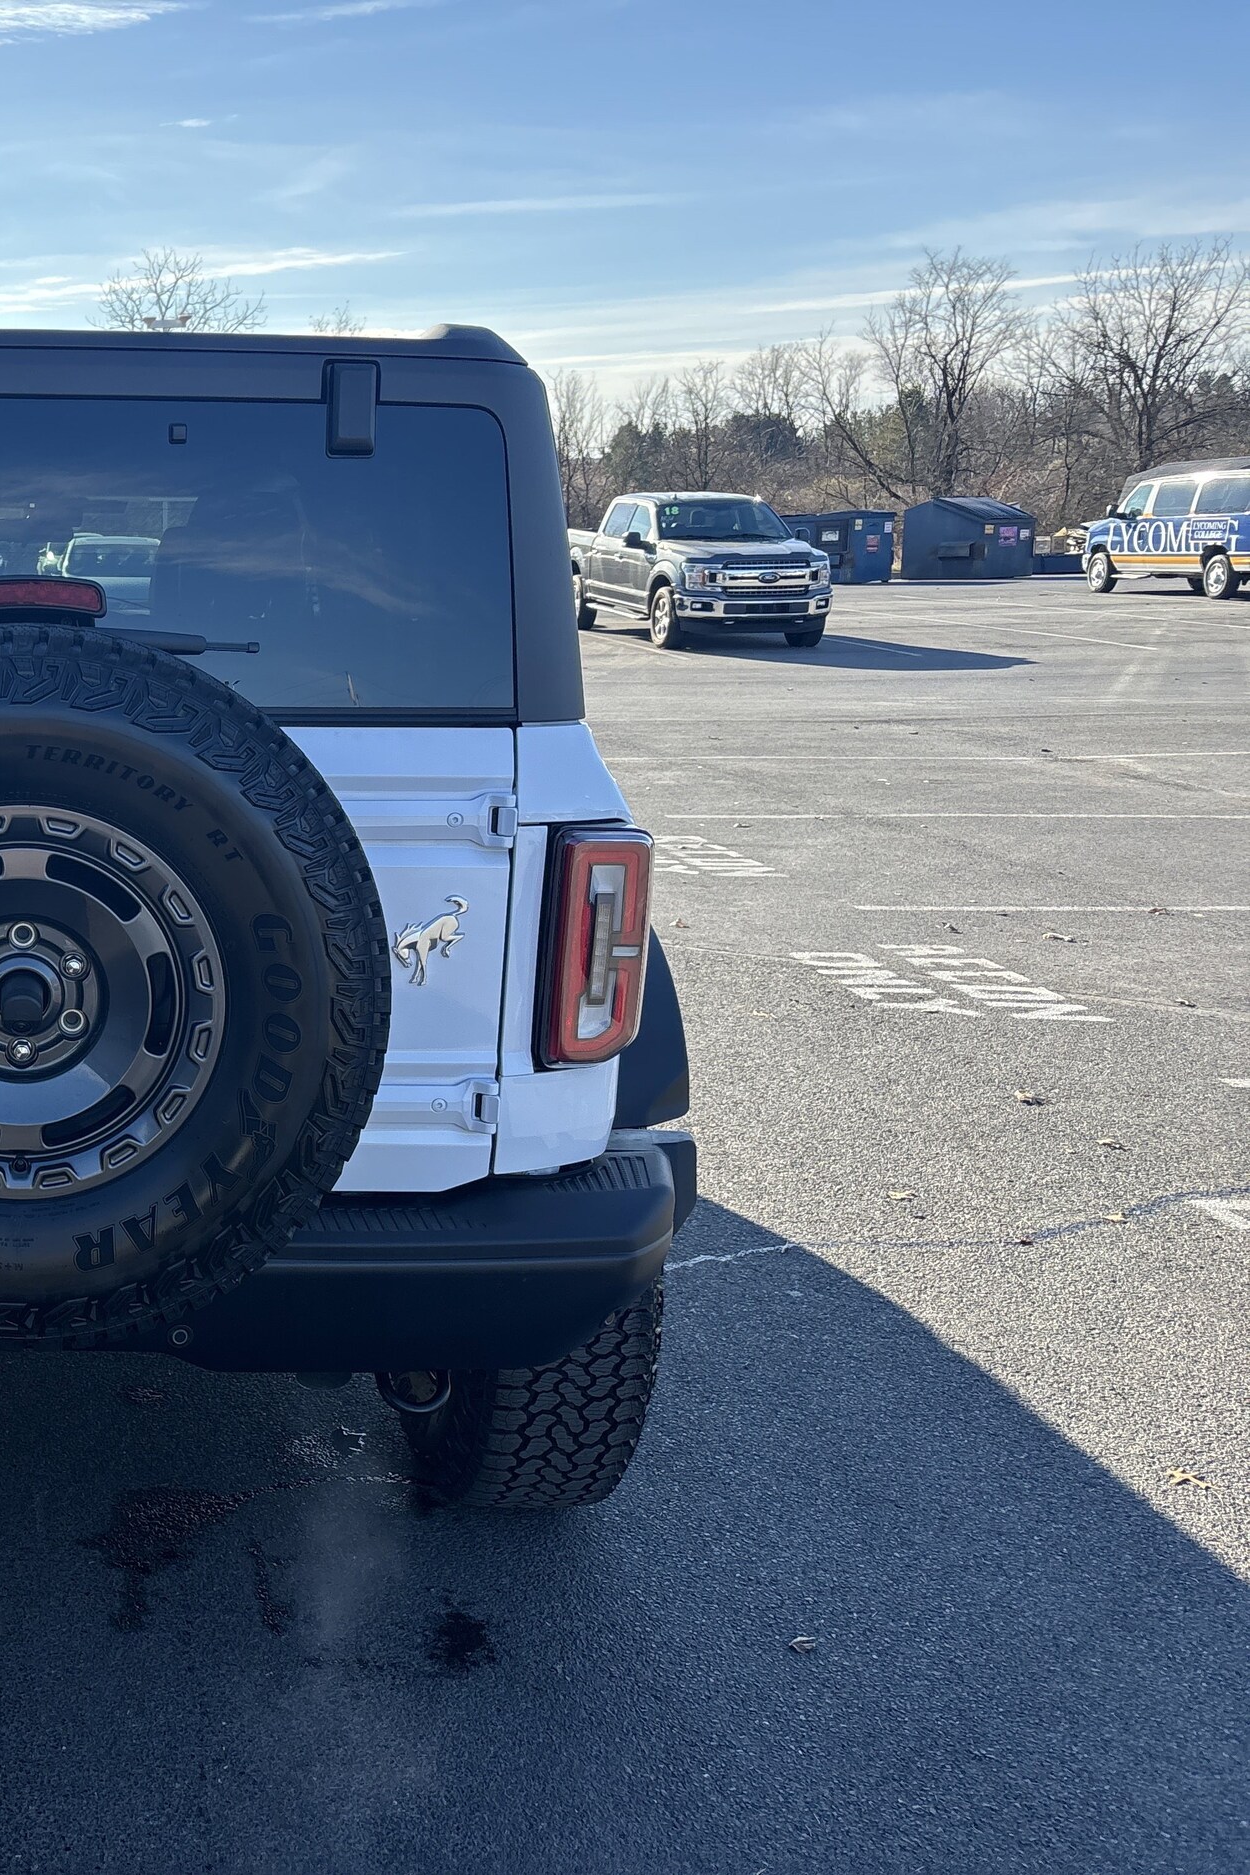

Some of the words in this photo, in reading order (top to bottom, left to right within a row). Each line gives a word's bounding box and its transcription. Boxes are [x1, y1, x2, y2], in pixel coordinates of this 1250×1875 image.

[664, 506, 679, 515] 18
[1192, 521, 1227, 530] LYCOMING
[25, 744, 194, 812] TERRITORY
[206, 828, 244, 862] RT
[788, 951, 985, 1016] ONLY
